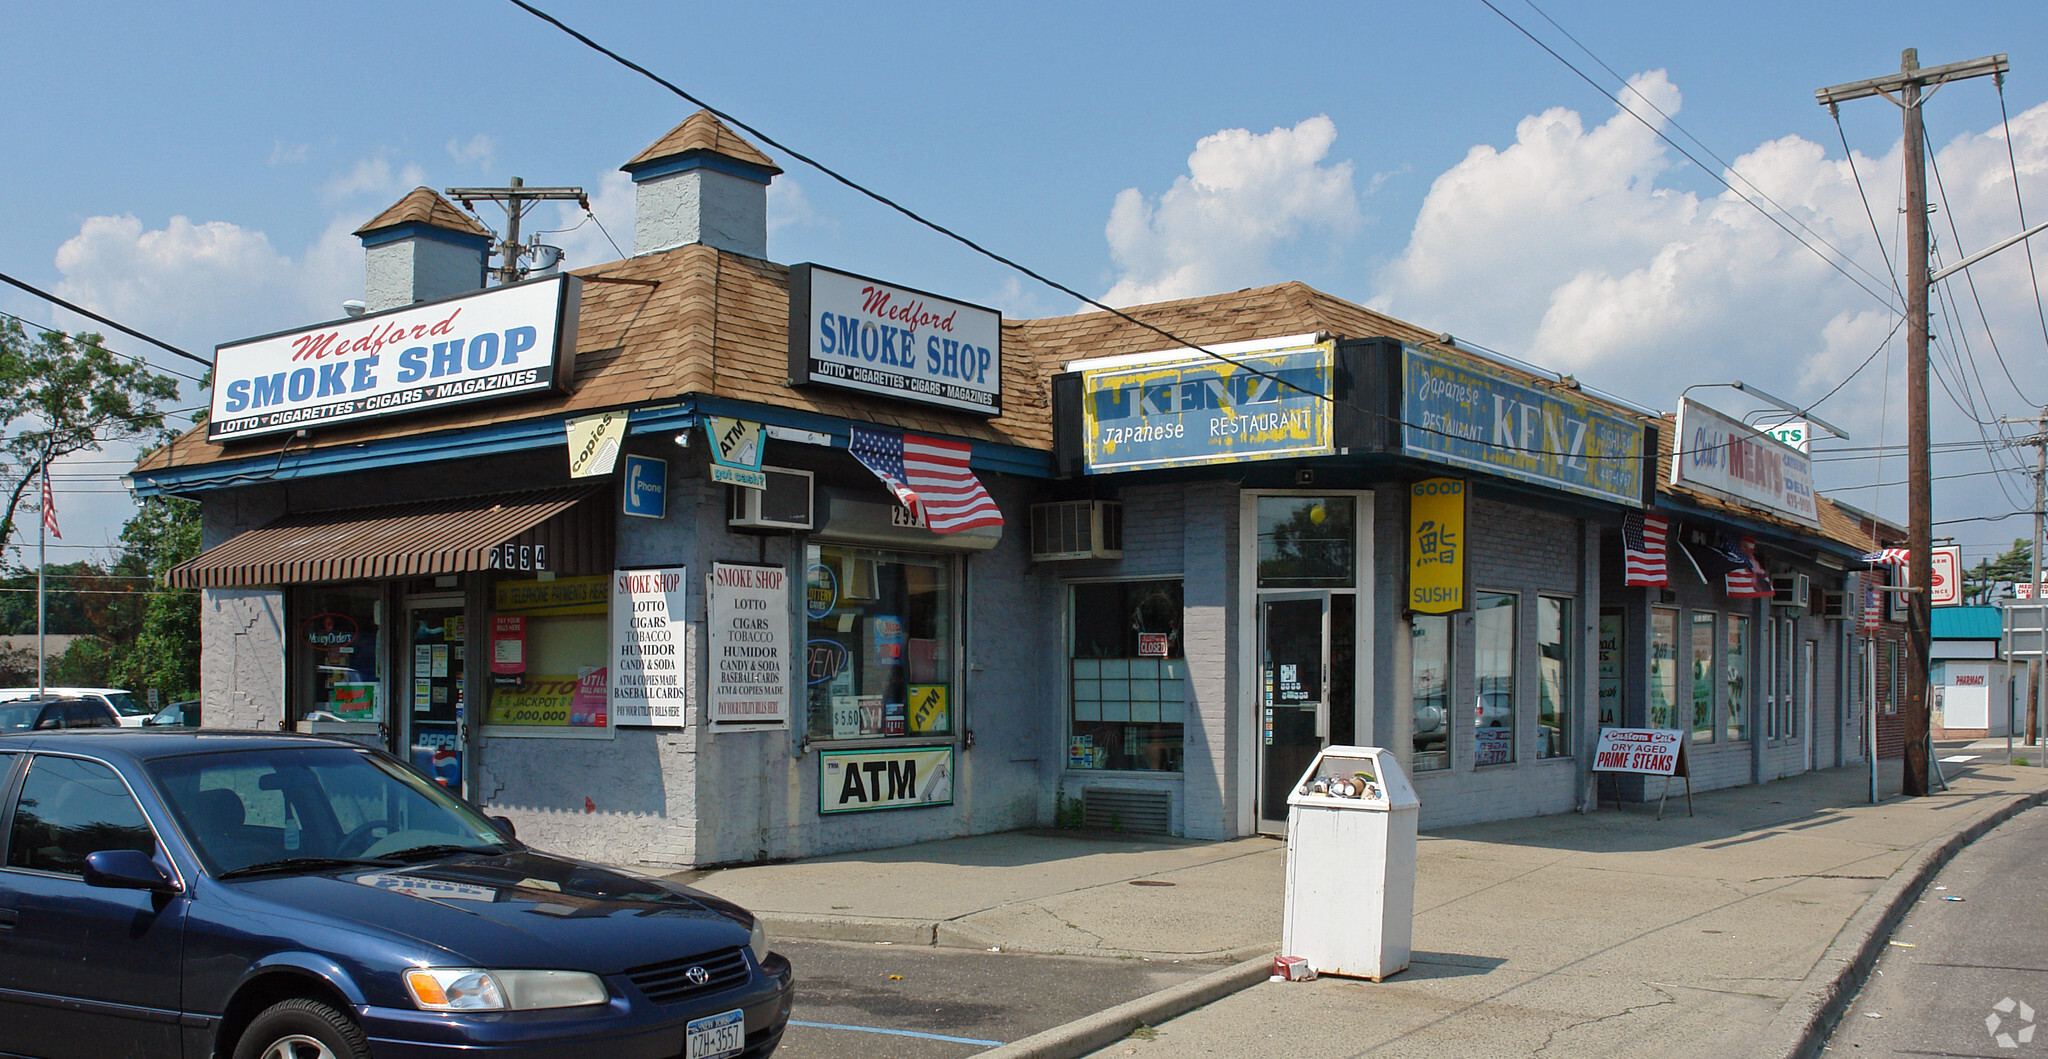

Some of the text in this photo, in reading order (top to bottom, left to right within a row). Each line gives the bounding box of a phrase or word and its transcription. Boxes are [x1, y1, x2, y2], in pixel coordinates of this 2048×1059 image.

[861, 286, 957, 333] Medford
[291, 307, 462, 362] Medford
[820, 311, 991, 384] SMOKE SHOP
[226, 325, 537, 412] SMOKE SHOP
[818, 360, 993, 406] LOTTO CIGARETTES CIGARS MAGAZINES
[1418, 370, 1479, 406] Japanese
[219, 369, 537, 433] LOTTO CIGARETTES CIGARS MAGAZINES
[1127, 371, 1280, 419] KENZ
[1210, 410, 1311, 438] RESTAURANT
[1421, 410, 1484, 446] RESTAURANT
[719, 419, 746, 457] ATM
[1492, 393, 1588, 472] KENZ
[572, 413, 613, 473] copies
[1728, 433, 1784, 498] MEATS
[714, 468, 765, 486] got cash?
[637, 480, 662, 494] Phone
[1413, 482, 1463, 497] GOOD
[1785, 477, 1810, 497] DELI
[490, 545, 545, 569] 2594
[619, 573, 680, 595] SMOKE SHOP
[717, 567, 782, 589] SMOKE SHOP
[1413, 587, 1458, 603] SUSHI
[632, 601, 665, 612] LOTTO
[734, 599, 767, 610] LOTTO
[630, 617, 666, 629] CIGARS
[733, 618, 768, 630] CIGARS
[625, 631, 672, 643] TOBACCO
[728, 631, 773, 643] TOBACCO
[621, 644, 675, 656] HUMIDOR
[724, 646, 777, 658] HUMIDOR
[1141, 642, 1165, 653] CLOSED
[620, 659, 675, 671] CANDY & SODA
[720, 660, 780, 672] CANDY & SODA
[619, 676, 633, 686] ATM
[638, 675, 659, 686] COPIES
[660, 675, 677, 686] MADE
[721, 672, 779, 683] BASEBALL CARDS
[1955, 675, 1985, 686] PHARMACY
[614, 687, 684, 699] BASEBALL CARDS
[716, 686, 732, 695] ATM
[739, 686, 763, 695] COPIES
[764, 686, 783, 695] MADE
[513, 697, 558, 707] JACKPOT
[914, 688, 941, 729] ATM
[668, 706, 680, 716] HERE
[1607, 730, 1674, 744] Custom Cut
[1635, 745, 1667, 754] AGED
[1597, 752, 1673, 771] PRIME STEAKS
[839, 759, 916, 804] ATM
